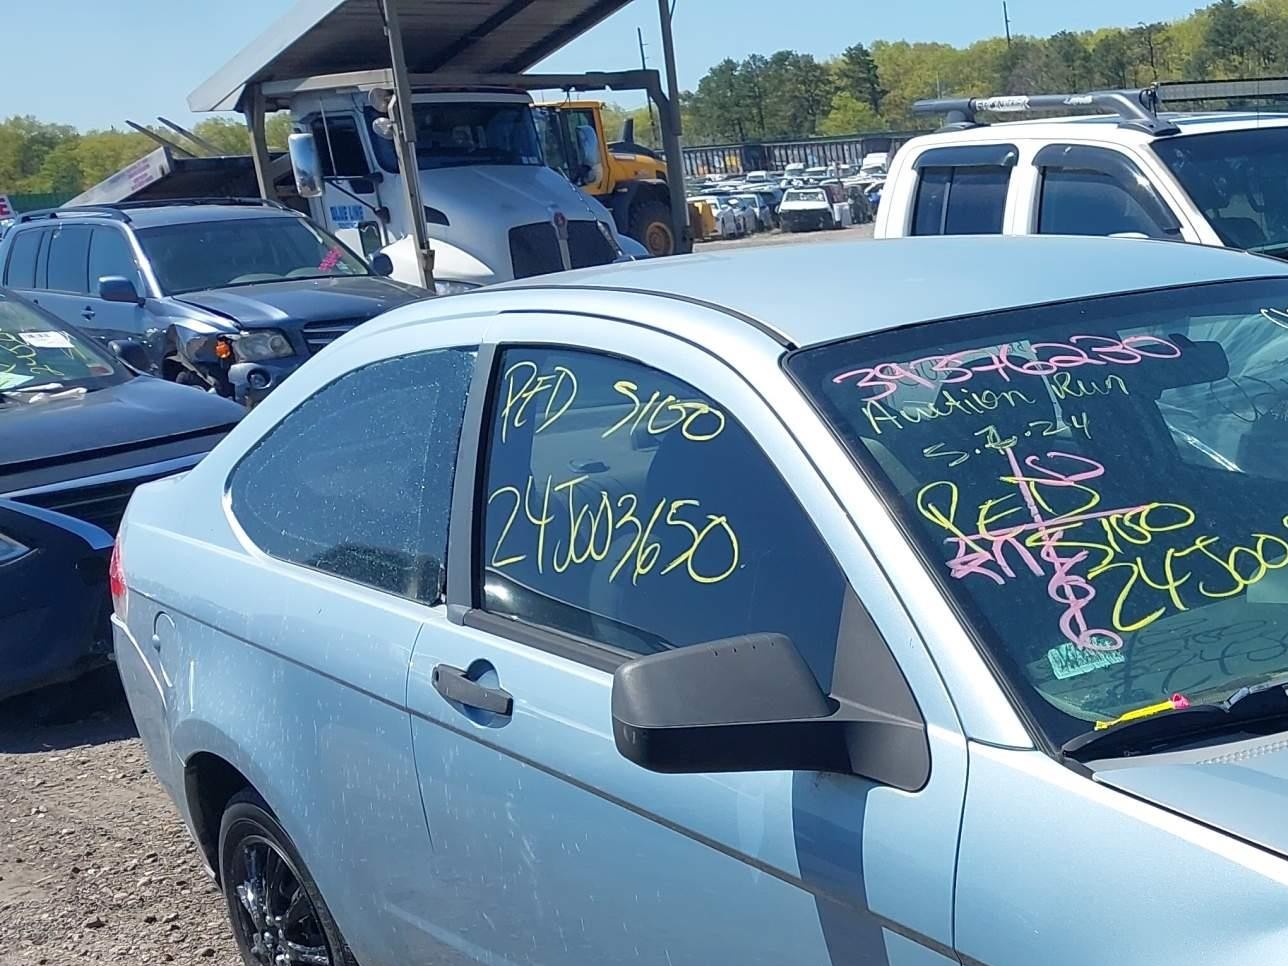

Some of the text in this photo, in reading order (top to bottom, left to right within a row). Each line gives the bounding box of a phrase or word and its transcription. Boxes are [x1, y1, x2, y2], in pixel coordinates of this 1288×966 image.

[833, 335, 1182, 401] 39376230
[1050, 371, 1130, 400] Run
[488, 475, 740, 585] 24J003650
